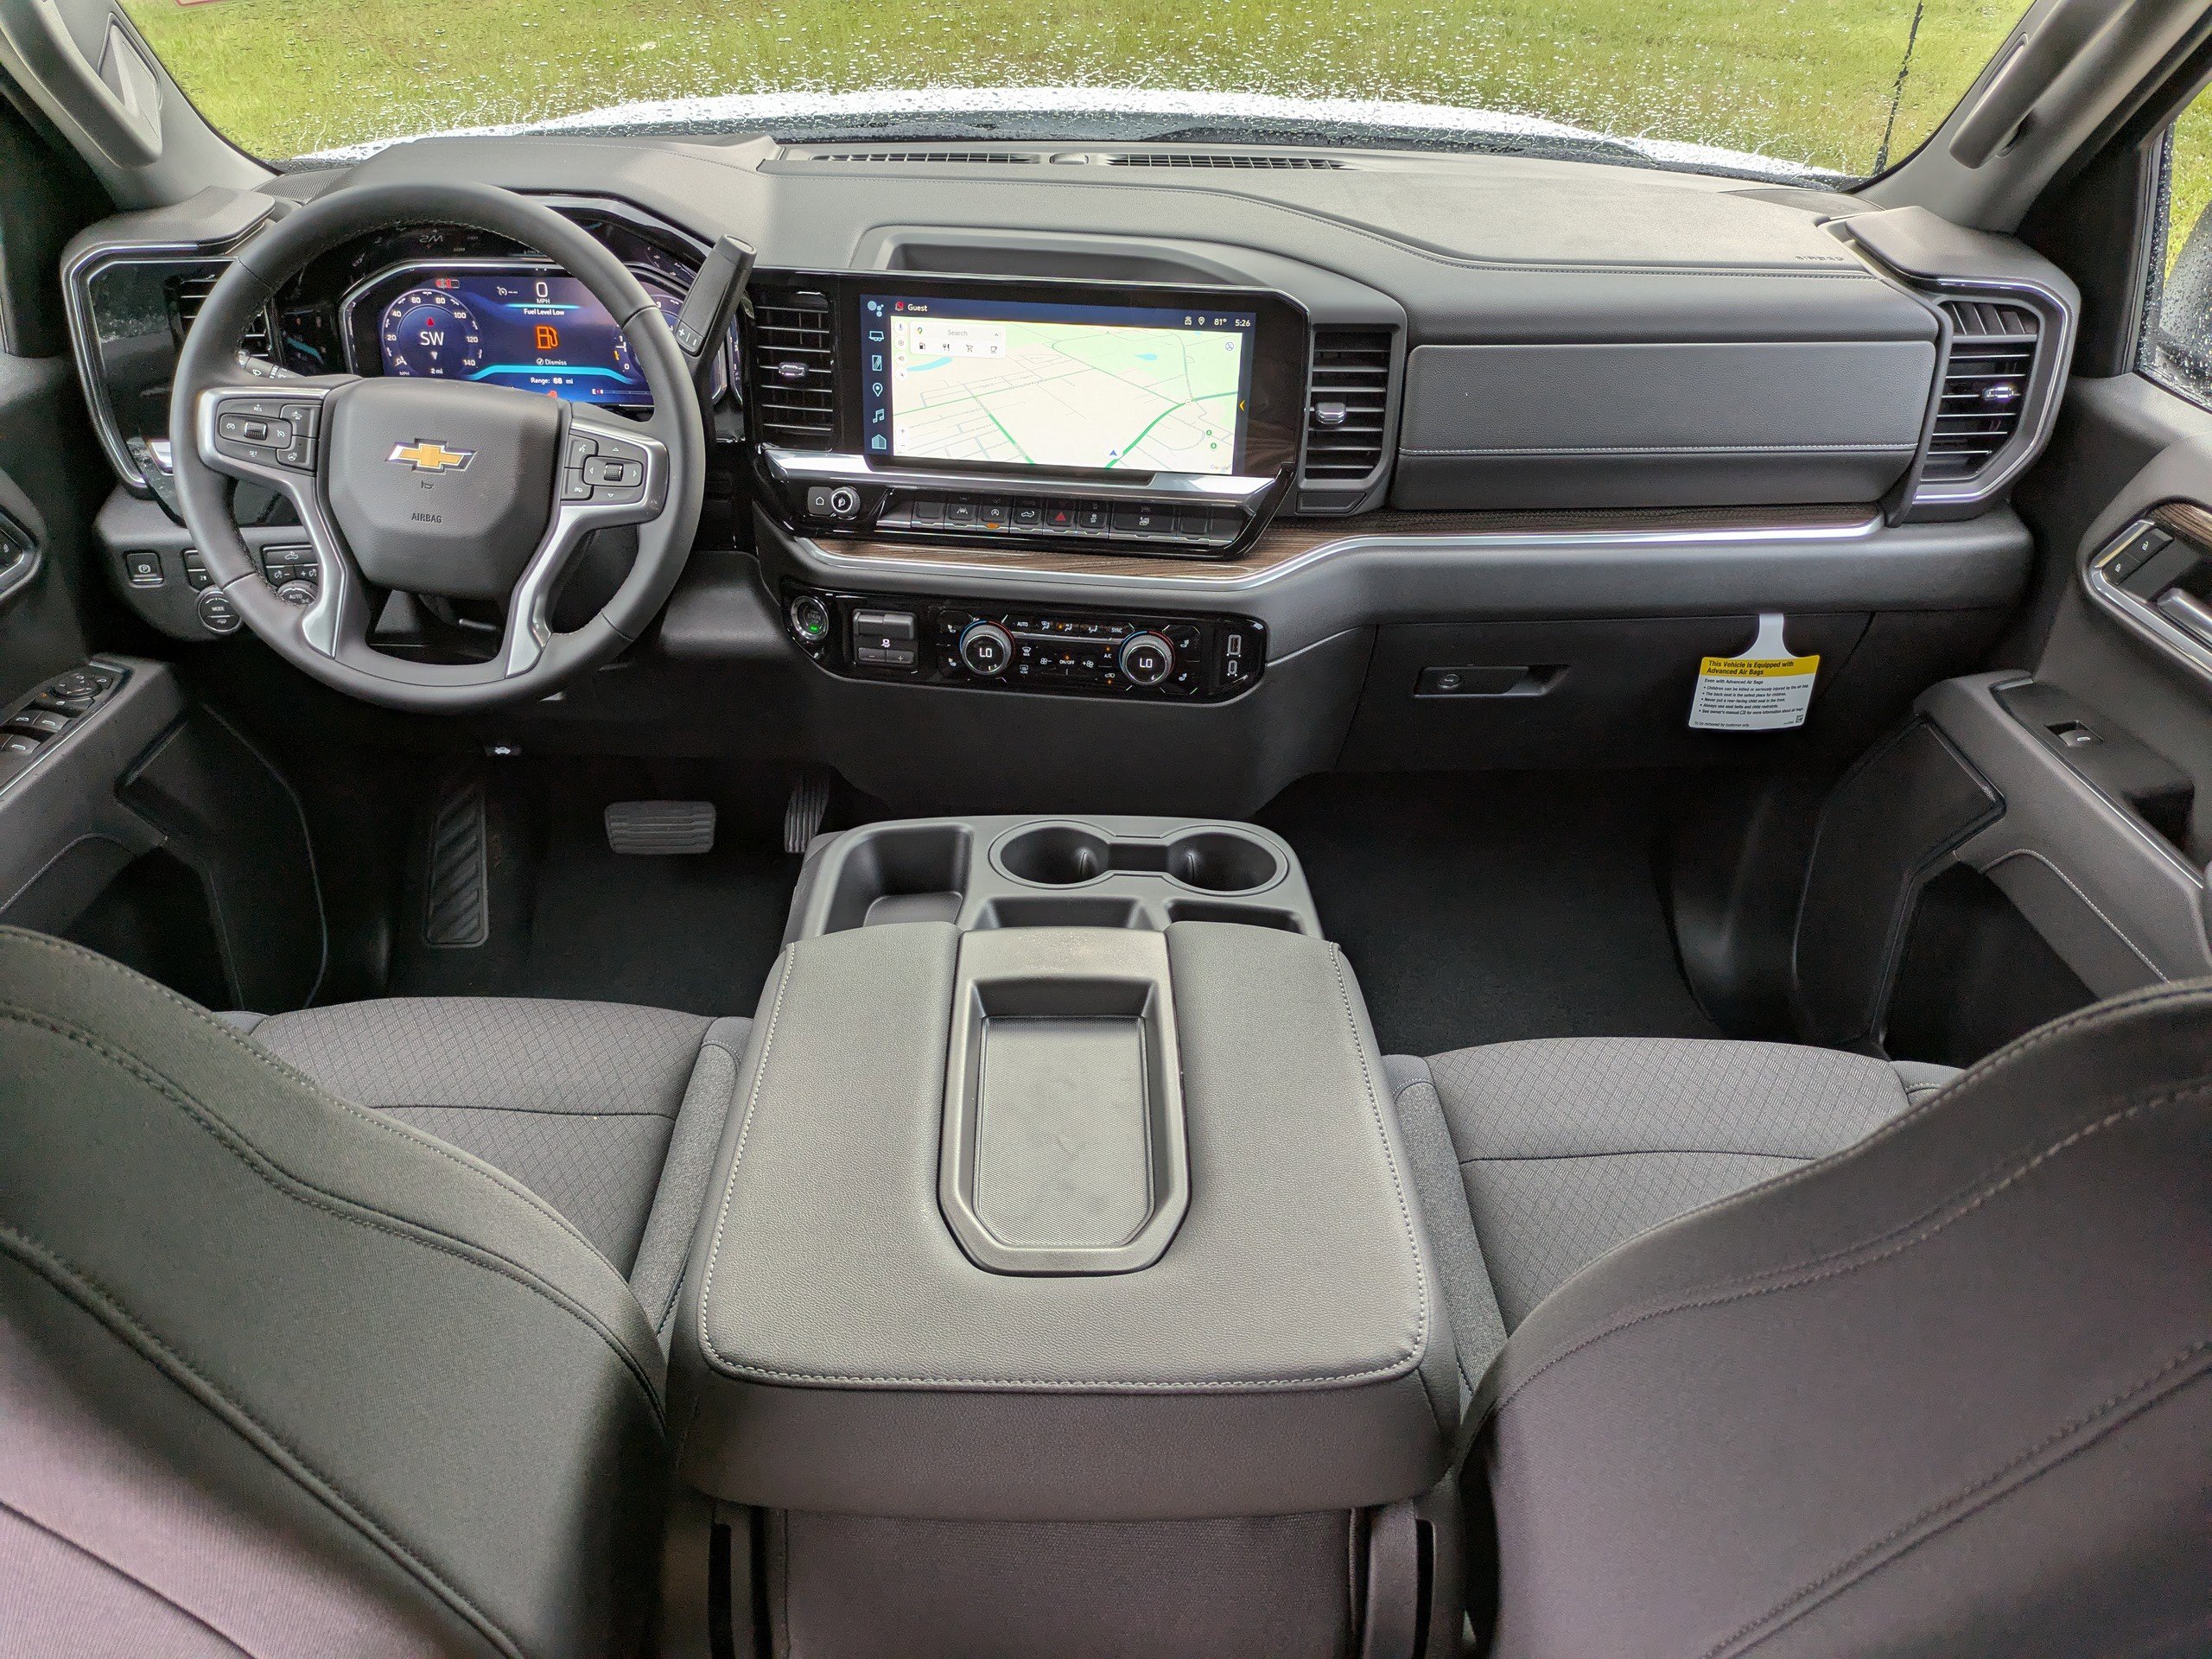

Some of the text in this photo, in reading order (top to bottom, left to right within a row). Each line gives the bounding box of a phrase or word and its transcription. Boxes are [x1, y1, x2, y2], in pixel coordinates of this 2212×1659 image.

[536, 282, 549, 298] 0
[907, 303, 928, 312] Guest
[420, 331, 444, 346] SW
[410, 512, 442, 524] AIRBAG
[979, 647, 993, 658] LO
[1139, 658, 1153, 669] LO
[1753, 661, 1781, 670] Equipped
